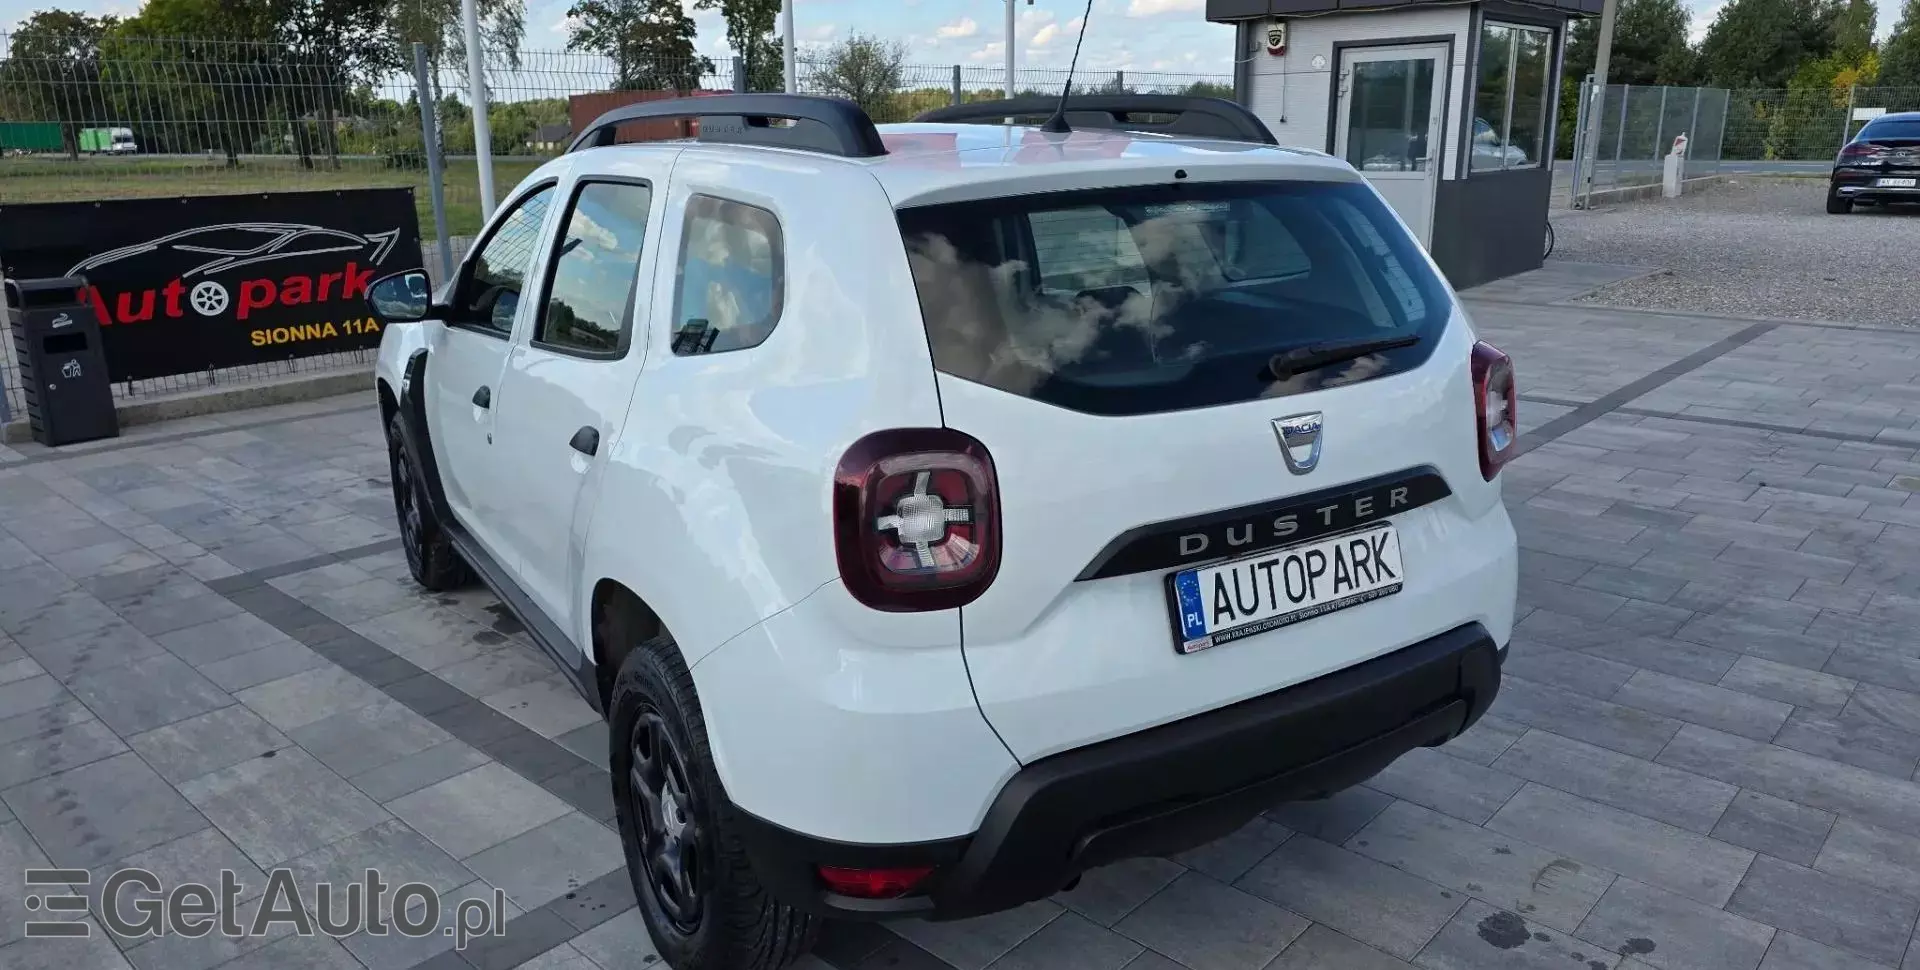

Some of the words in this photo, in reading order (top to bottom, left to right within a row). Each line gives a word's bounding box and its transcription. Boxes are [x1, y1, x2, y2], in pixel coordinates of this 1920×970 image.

[250, 322, 338, 346] SIONNA
[342, 316, 380, 336] 11A
[1179, 486, 1409, 556] DUSTER
[1213, 531, 1396, 626] AUTOPARK
[1187, 612, 1203, 628] PL
